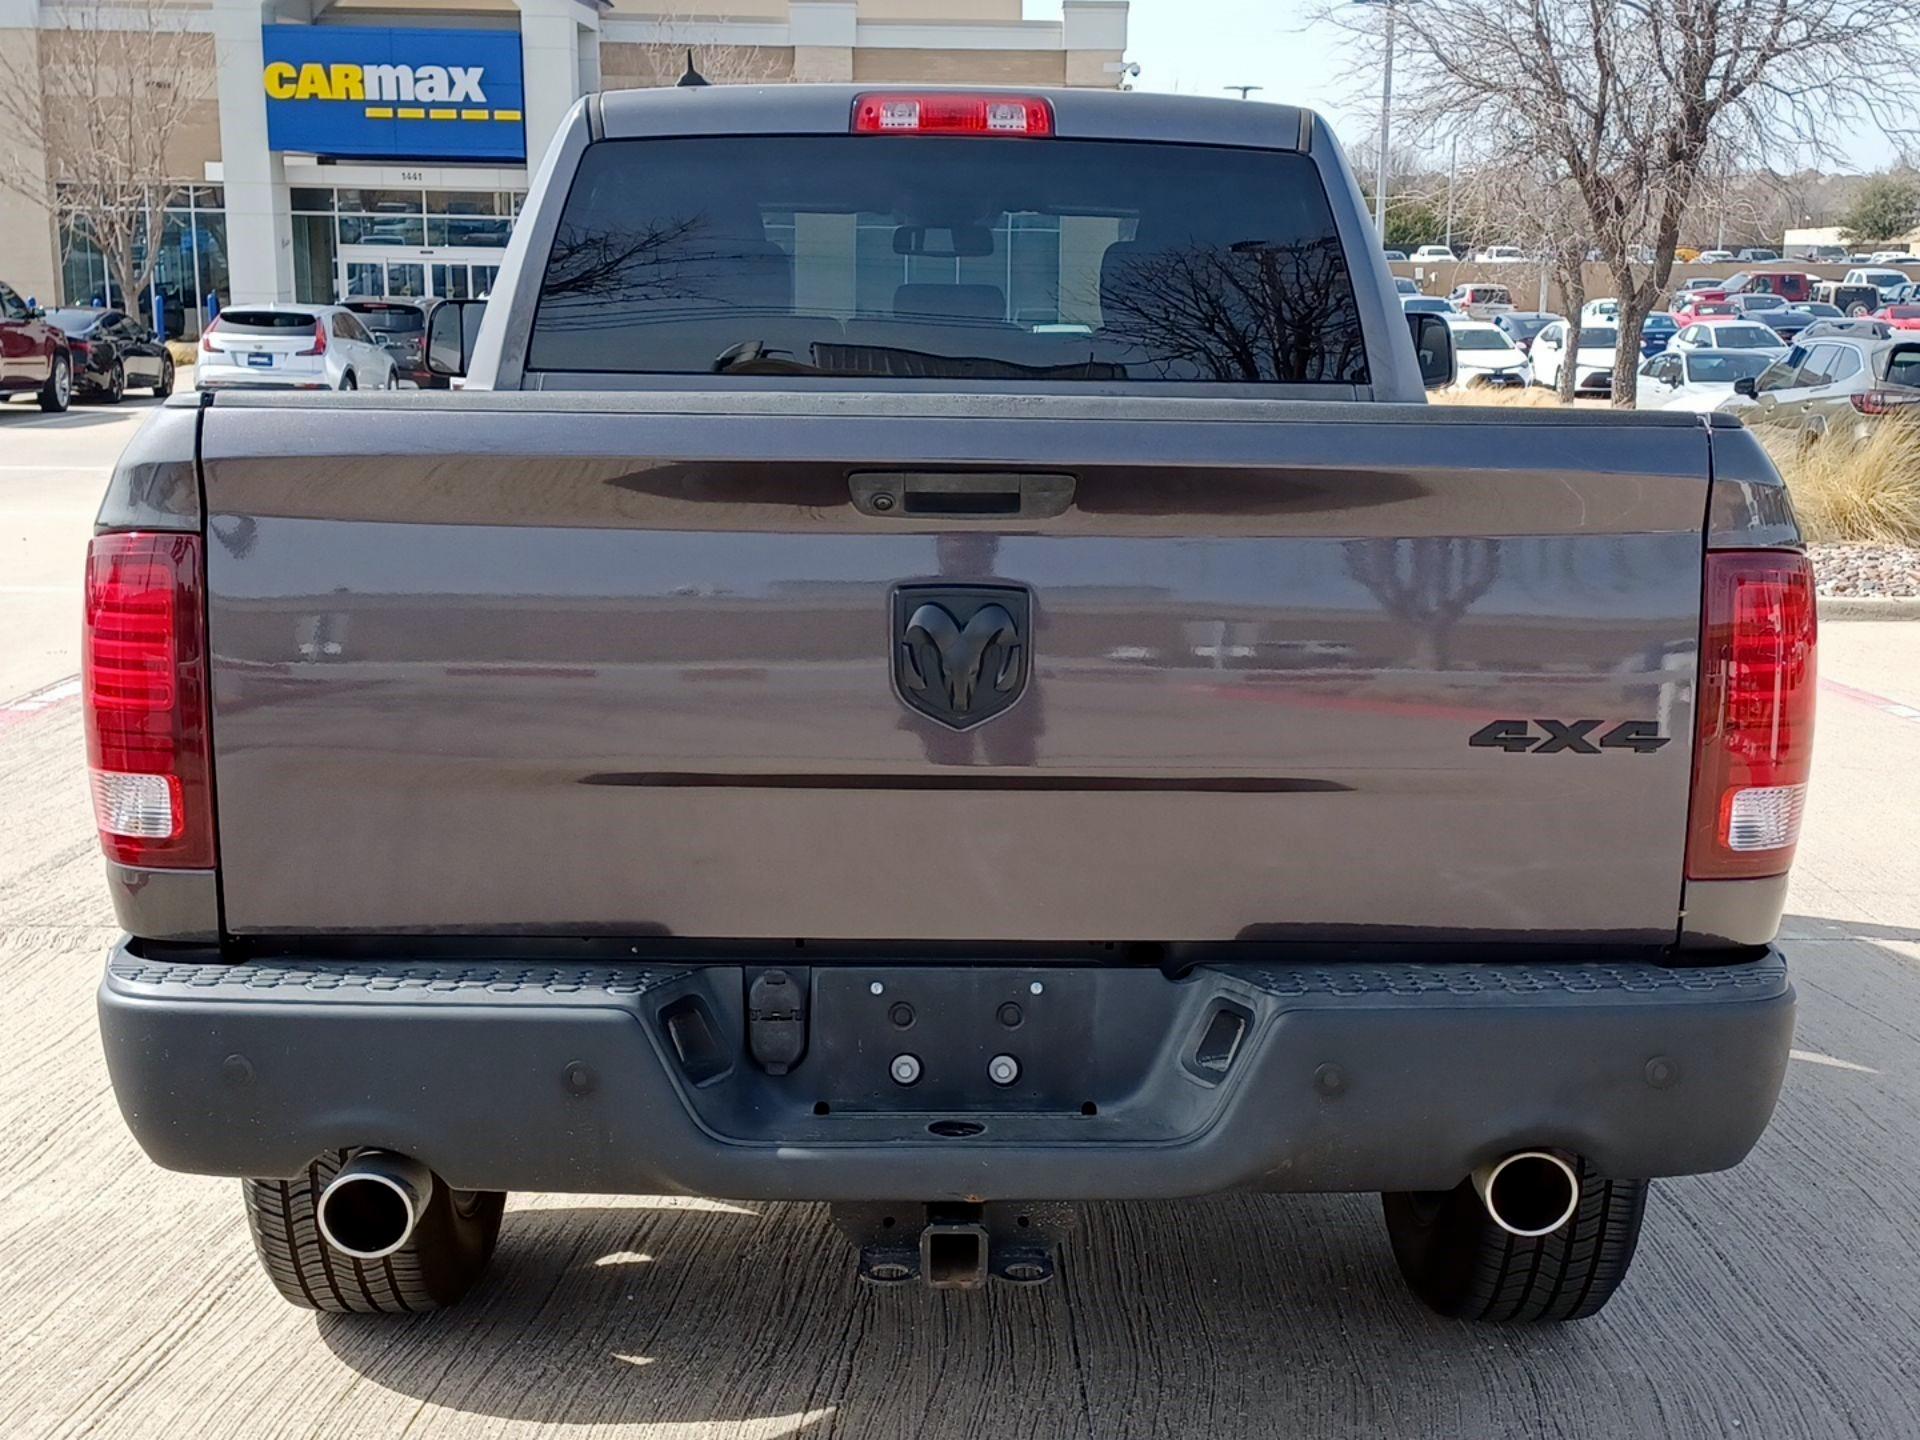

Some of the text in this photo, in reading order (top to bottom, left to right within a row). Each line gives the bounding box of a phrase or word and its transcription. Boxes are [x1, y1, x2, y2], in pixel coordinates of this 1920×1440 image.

[263, 61, 487, 102] CARmax
[401, 172, 423, 181] 1441
[1469, 719, 1671, 753] 4X4
